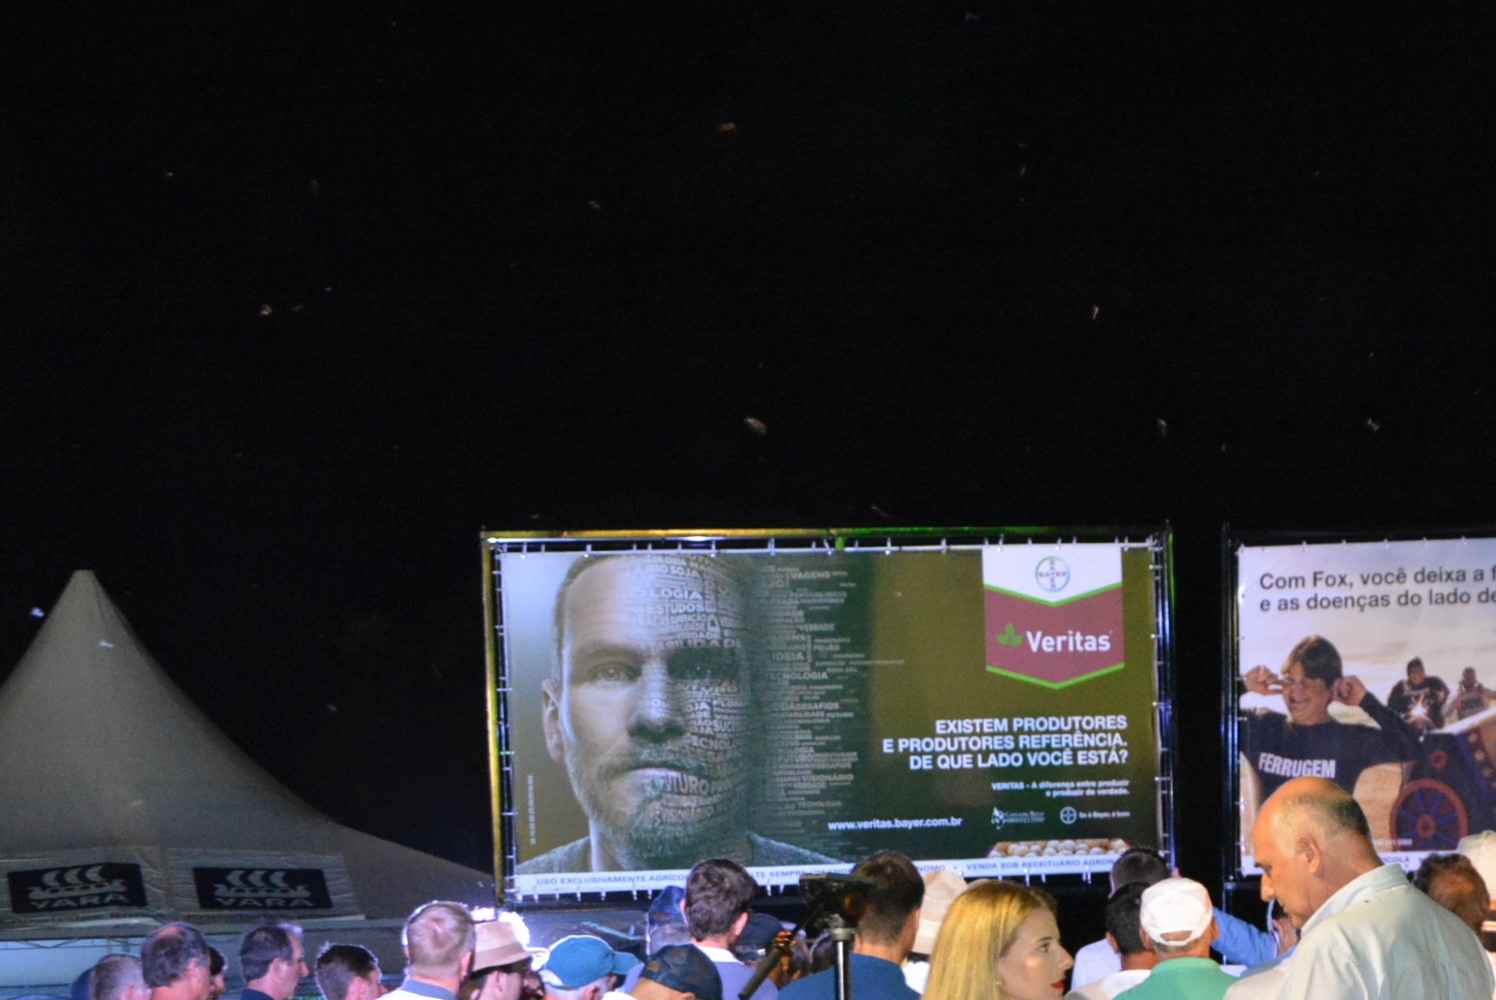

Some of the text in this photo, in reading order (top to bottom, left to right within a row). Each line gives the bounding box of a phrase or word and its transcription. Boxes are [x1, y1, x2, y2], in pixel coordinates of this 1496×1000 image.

[1260, 572, 1306, 590] Com
[1312, 570, 1353, 590] Fox,
[1361, 568, 1406, 586] você
[1414, 567, 1466, 584] deixa
[1473, 570, 1485, 583] a
[1260, 598, 1271, 611] e
[1278, 598, 1300, 611] as
[1306, 592, 1390, 612] doenças
[1397, 590, 1422, 607] do
[1428, 588, 1471, 605] lado
[1026, 631, 1111, 653] Veritas
[935, 715, 1128, 735] EXISTEM PRODUTORES
[883, 729, 1128, 753] E PRODUTORES REFERÊNCIA.
[910, 746, 1129, 770] DE QUE LADO VOCÊ ESTÁ?
[1258, 752, 1336, 779] FERRUGEM
[991, 782, 1024, 791] VERITAS
[1076, 780, 1096, 788] entre
[1098, 779, 1130, 789] produzir
[1053, 788, 1084, 798] produzir
[1086, 788, 1096, 796] de
[1097, 787, 1130, 796] verdade.
[828, 817, 962, 831] www.veritas.bayer.com.br
[966, 858, 1115, 871] VENDA SOB RECEITUÁRIO AGRON
[536, 872, 689, 886] USO EXCLUSIVAMENTE AGRÍCO
[30, 892, 130, 910] YARA
[216, 897, 315, 909] YARA
